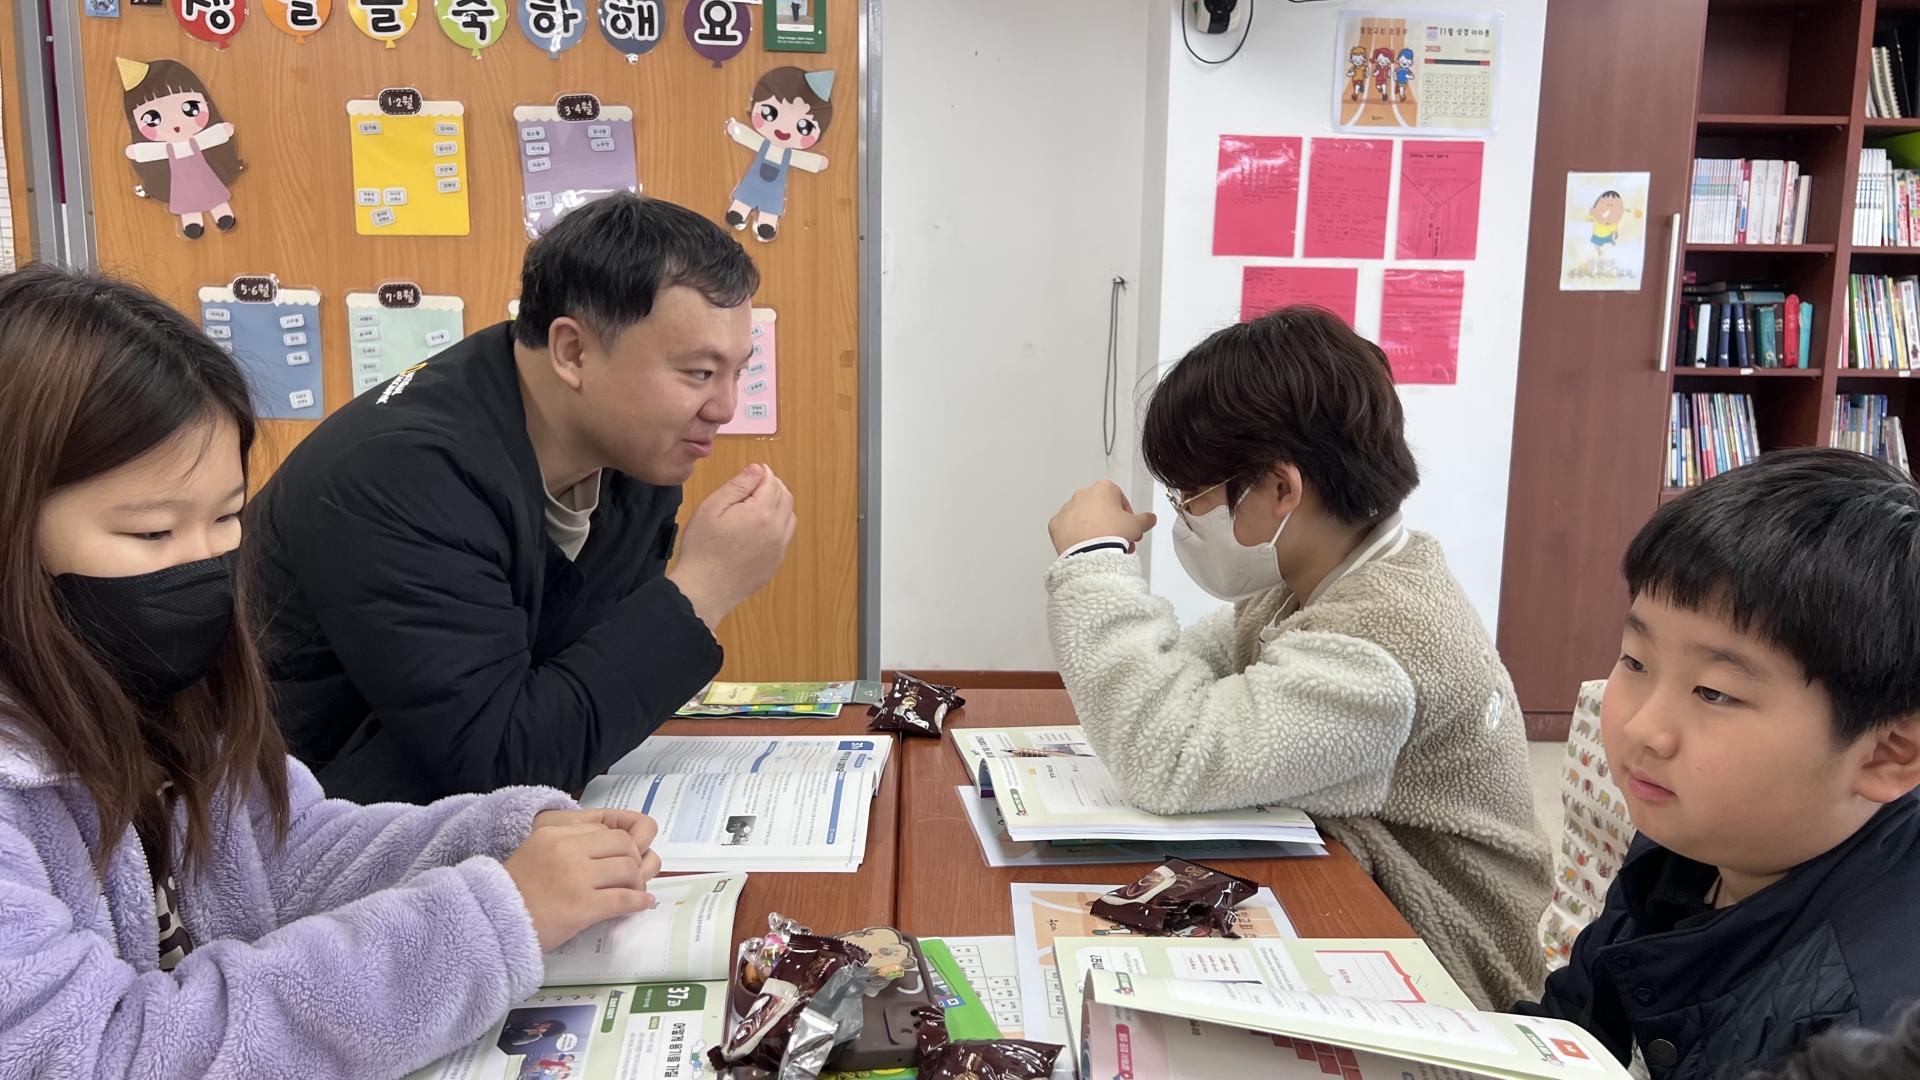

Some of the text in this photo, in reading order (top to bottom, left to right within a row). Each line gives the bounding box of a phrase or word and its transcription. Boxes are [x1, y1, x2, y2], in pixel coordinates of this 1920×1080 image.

[451, 0, 738, 42] 축하해요
[666, 985, 690, 1007] 37과
[664, 1022, 686, 1079] 어떻게 용기를 가질
